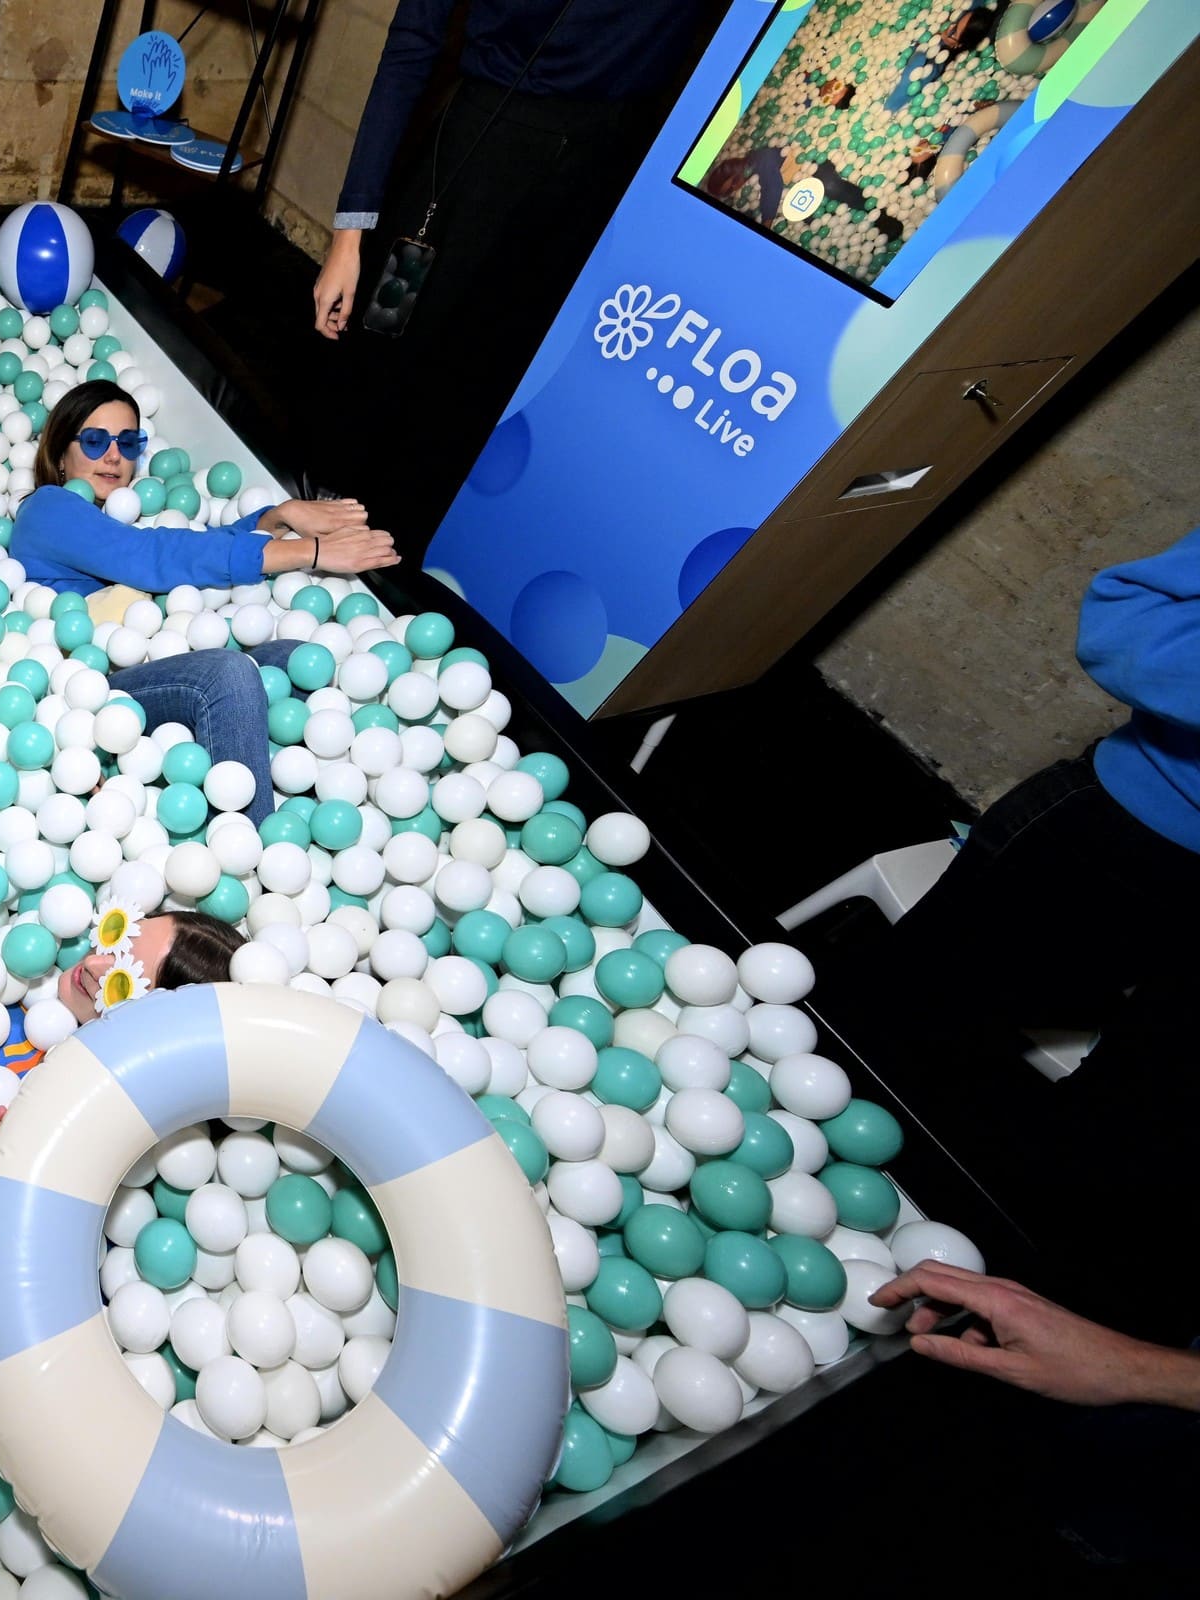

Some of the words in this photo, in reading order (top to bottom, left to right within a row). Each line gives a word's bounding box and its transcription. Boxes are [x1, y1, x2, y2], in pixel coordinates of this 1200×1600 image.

[130, 87, 153, 99] Make
[155, 90, 162, 101] it
[200, 149, 226, 158] FLO
[666, 309, 797, 422] FLOa
[694, 399, 755, 457] Live
